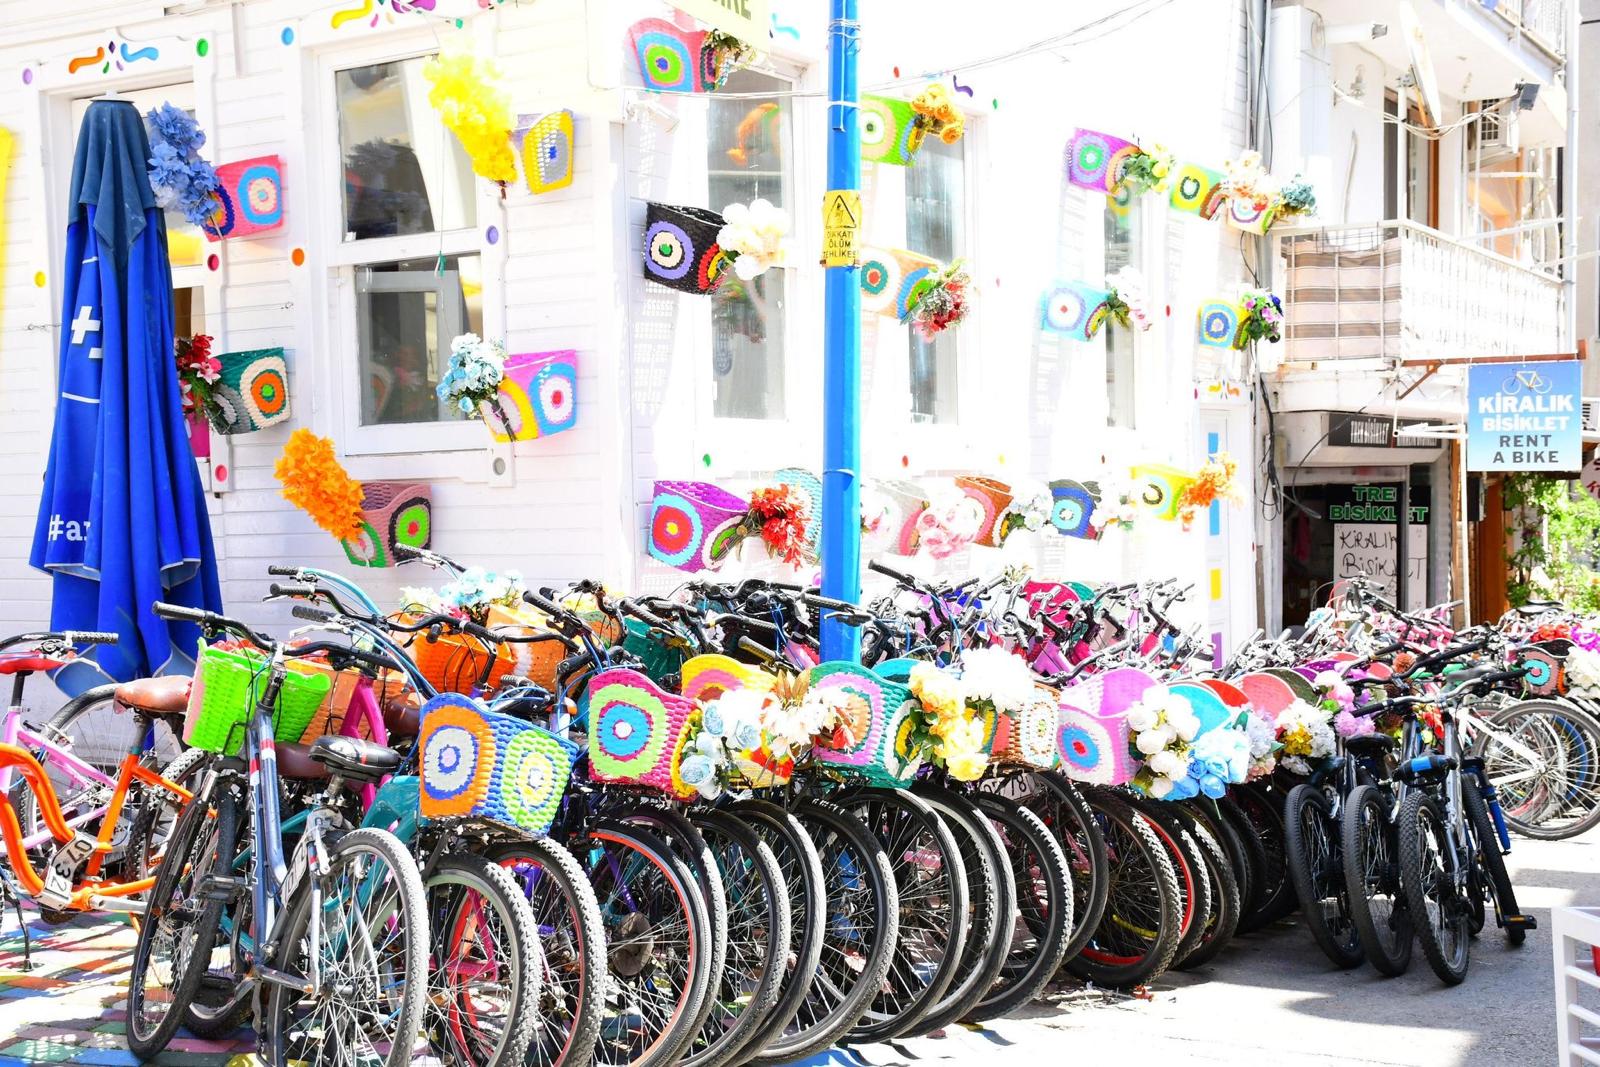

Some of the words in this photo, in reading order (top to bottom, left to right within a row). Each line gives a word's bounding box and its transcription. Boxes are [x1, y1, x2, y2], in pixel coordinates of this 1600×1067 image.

[828, 238, 851, 249] ÖLÜM
[1478, 392, 1574, 413] KİRALIK
[1482, 414, 1570, 432] BİSİKLET
[1499, 435, 1552, 447] RENT
[1493, 451, 1505, 463] A
[1512, 451, 1559, 463] BIKE
[1352, 486, 1411, 502] TRE
